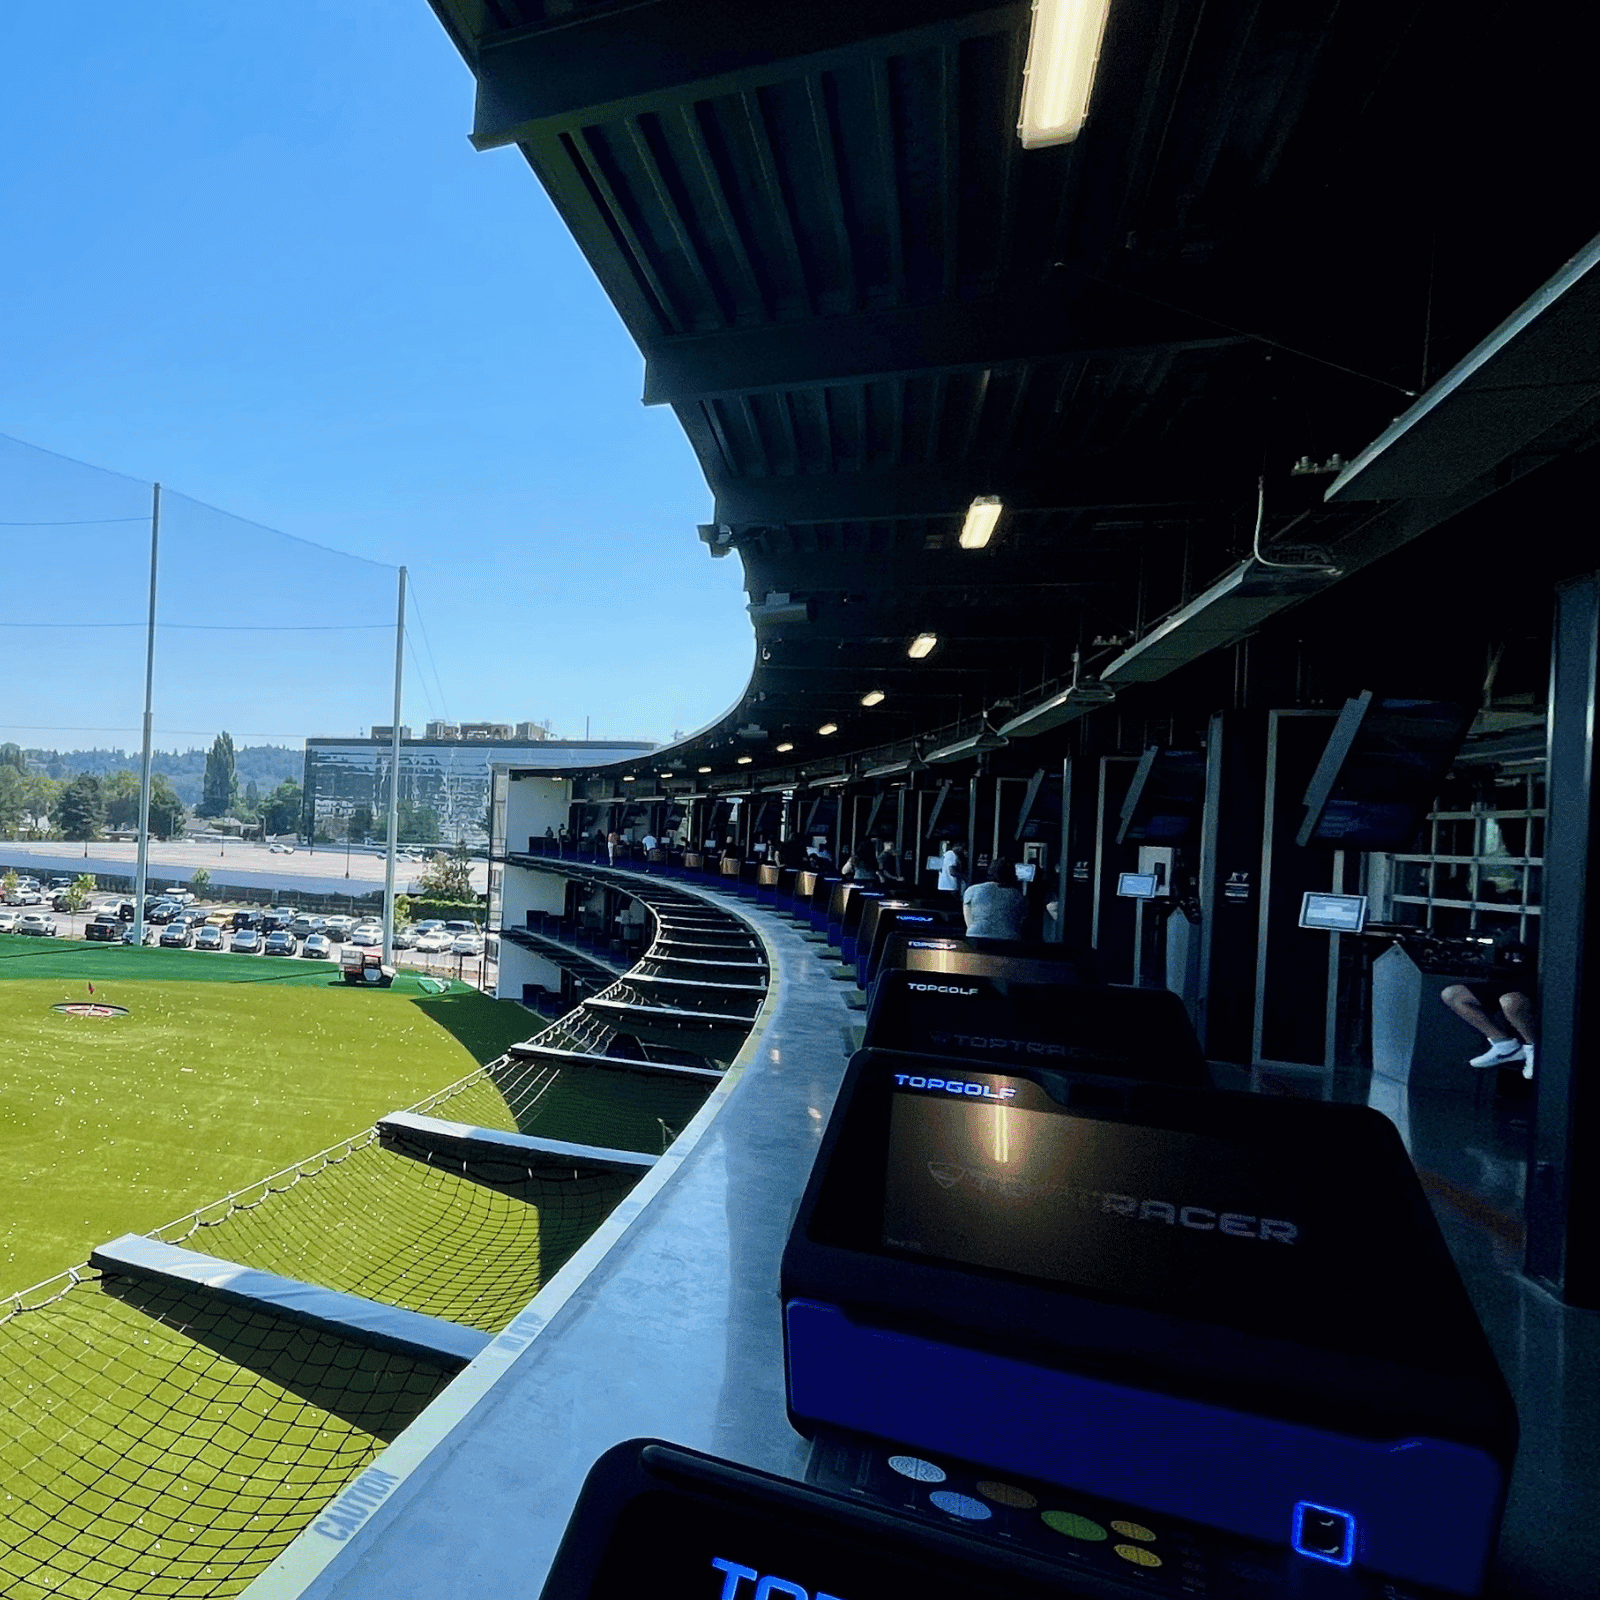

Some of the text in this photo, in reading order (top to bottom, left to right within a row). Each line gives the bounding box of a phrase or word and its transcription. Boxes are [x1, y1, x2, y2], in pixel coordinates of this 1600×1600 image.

[907, 982, 980, 996] TOPGOLF
[953, 1033, 1129, 1063] TOPTRAC
[894, 1073, 1018, 1101] TOPGOLF
[313, 1466, 400, 1541] CAUTION
[711, 1556, 844, 1600] TO
